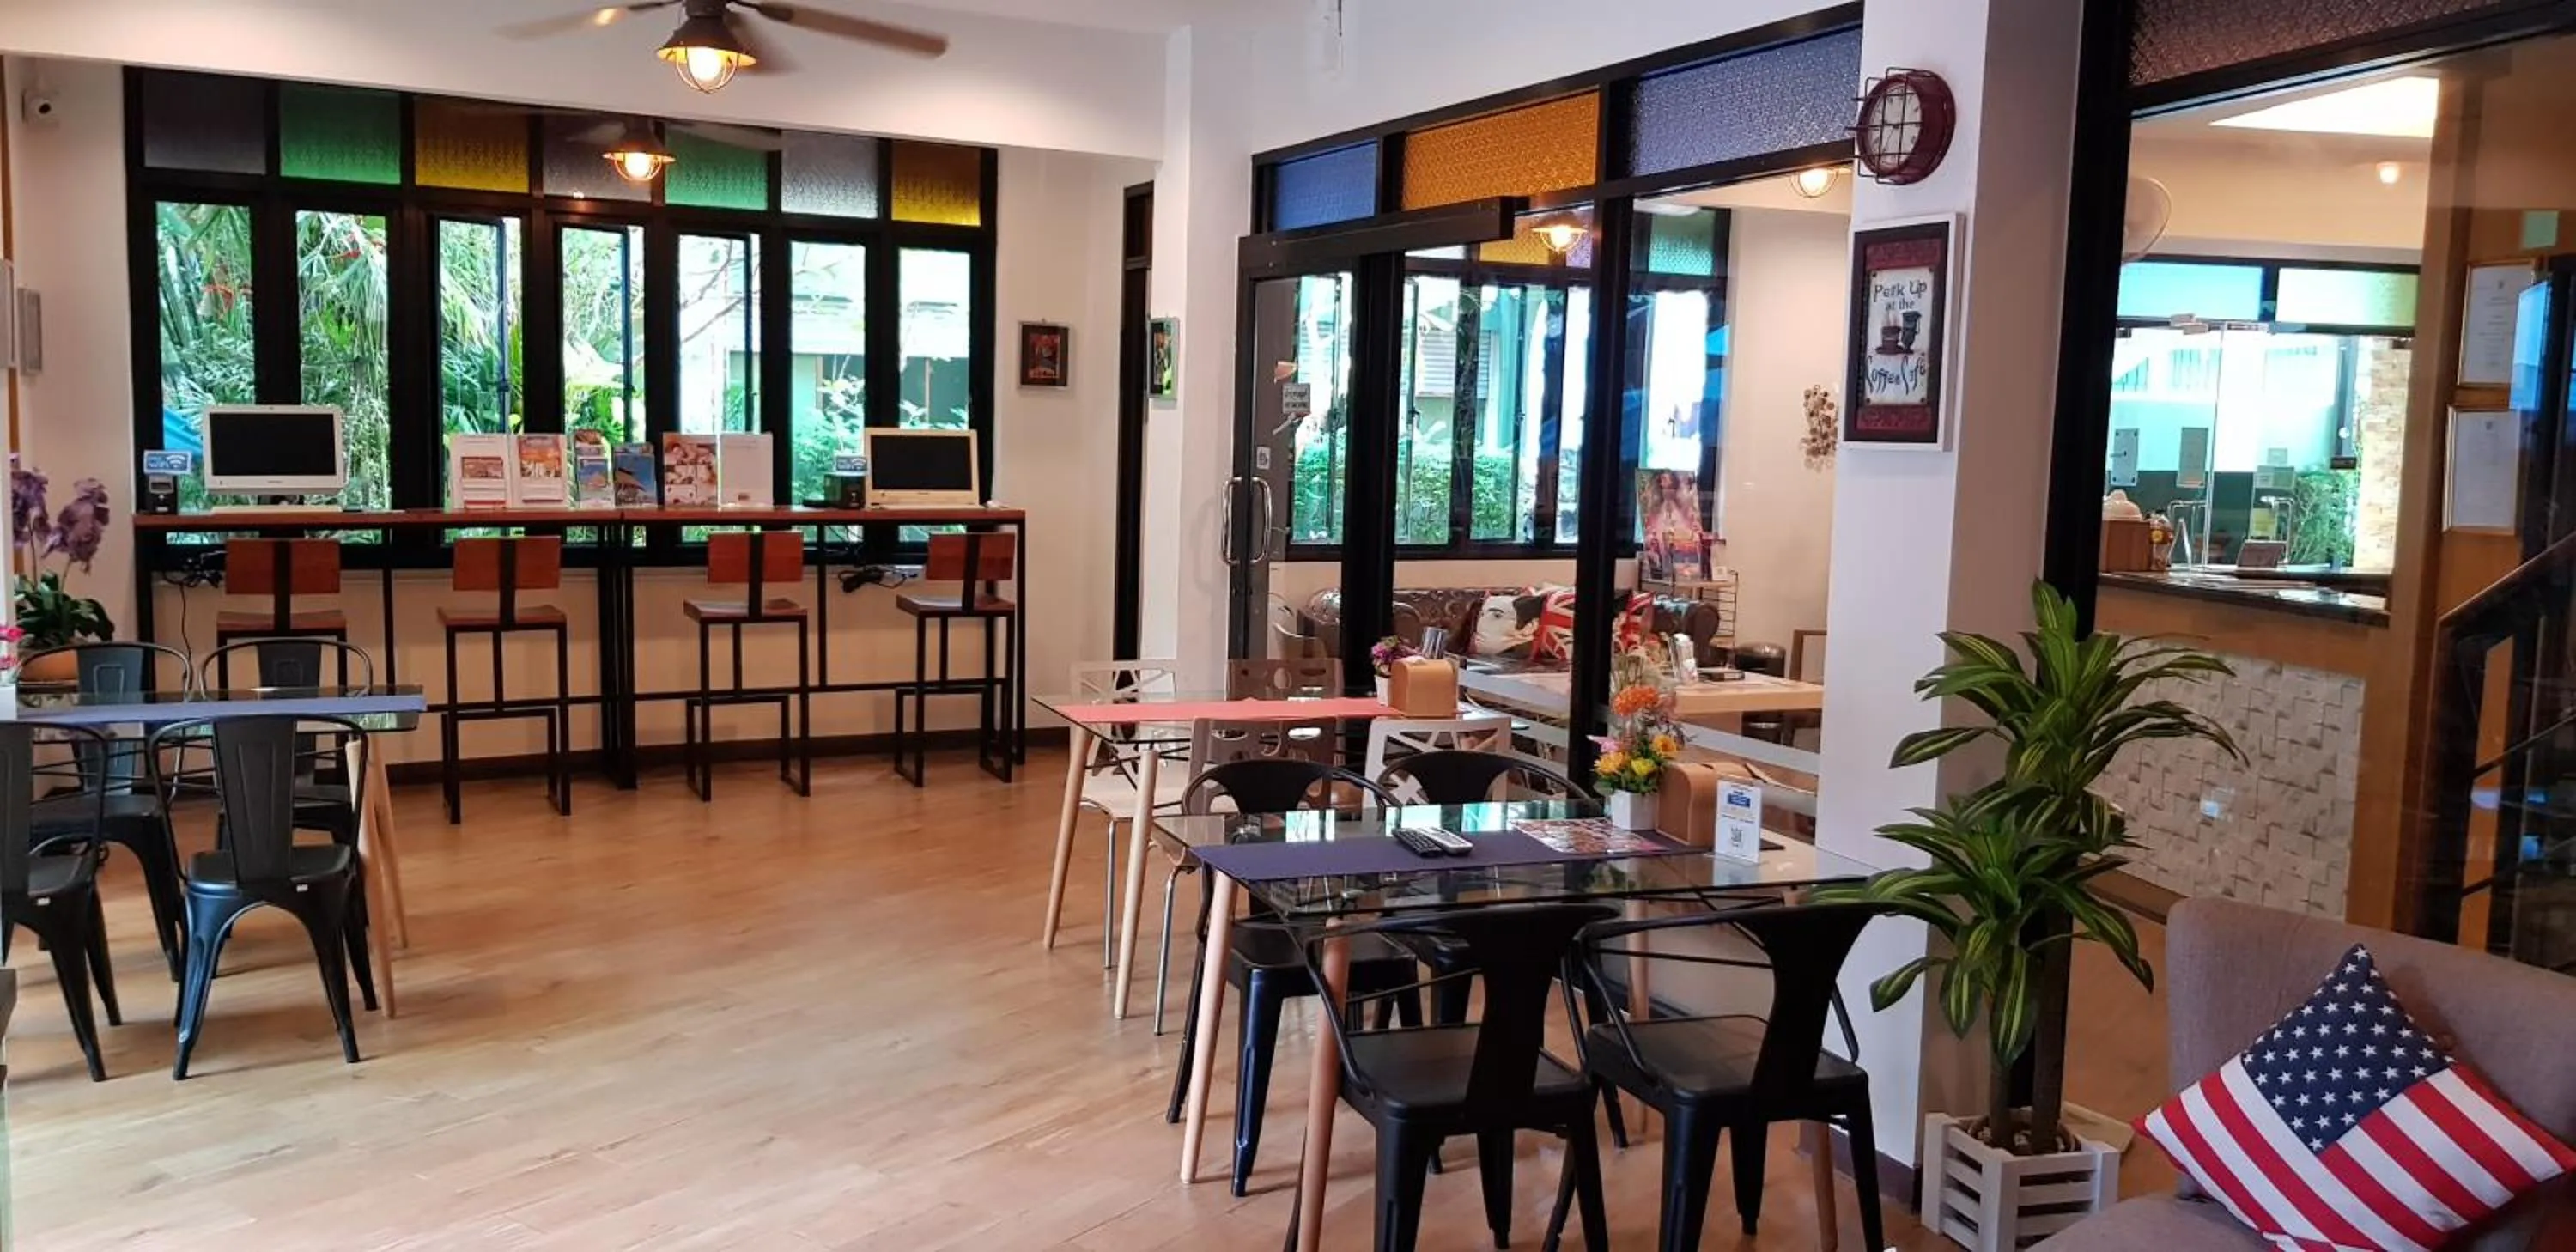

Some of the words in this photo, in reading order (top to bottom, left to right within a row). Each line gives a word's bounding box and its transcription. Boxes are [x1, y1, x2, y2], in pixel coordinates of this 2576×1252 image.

[1874, 283, 1905, 302] Perk
[1909, 279, 1928, 299] Up
[1885, 301, 1896, 311] at
[1899, 298, 1916, 310] the
[1866, 355, 1900, 393] Coffee
